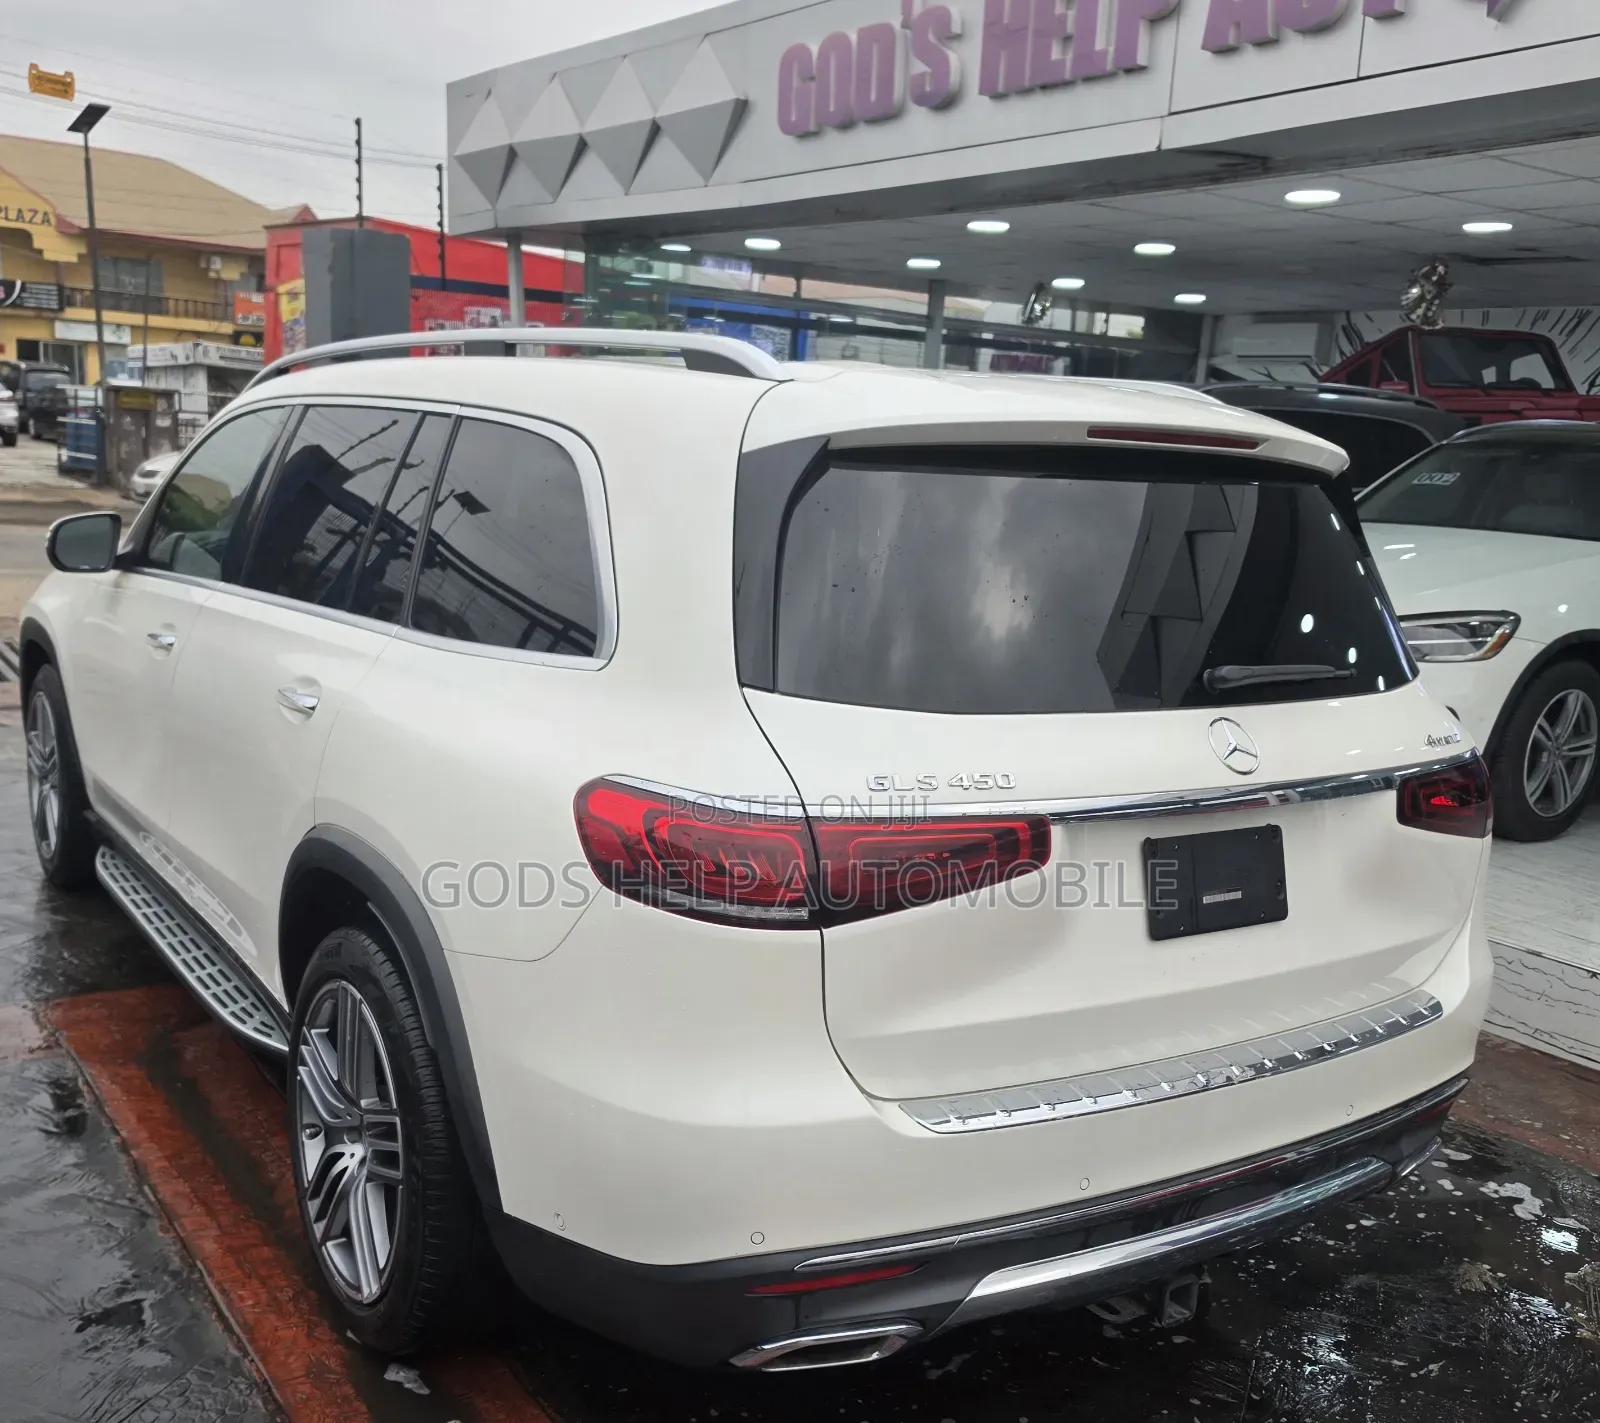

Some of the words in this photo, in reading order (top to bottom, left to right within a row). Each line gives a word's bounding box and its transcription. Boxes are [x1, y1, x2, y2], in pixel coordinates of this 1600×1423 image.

[979, 0, 1181, 98] HELP
[0, 205, 52, 225] LAZA
[867, 774, 940, 790] GLS
[948, 772, 1016, 788] 450
